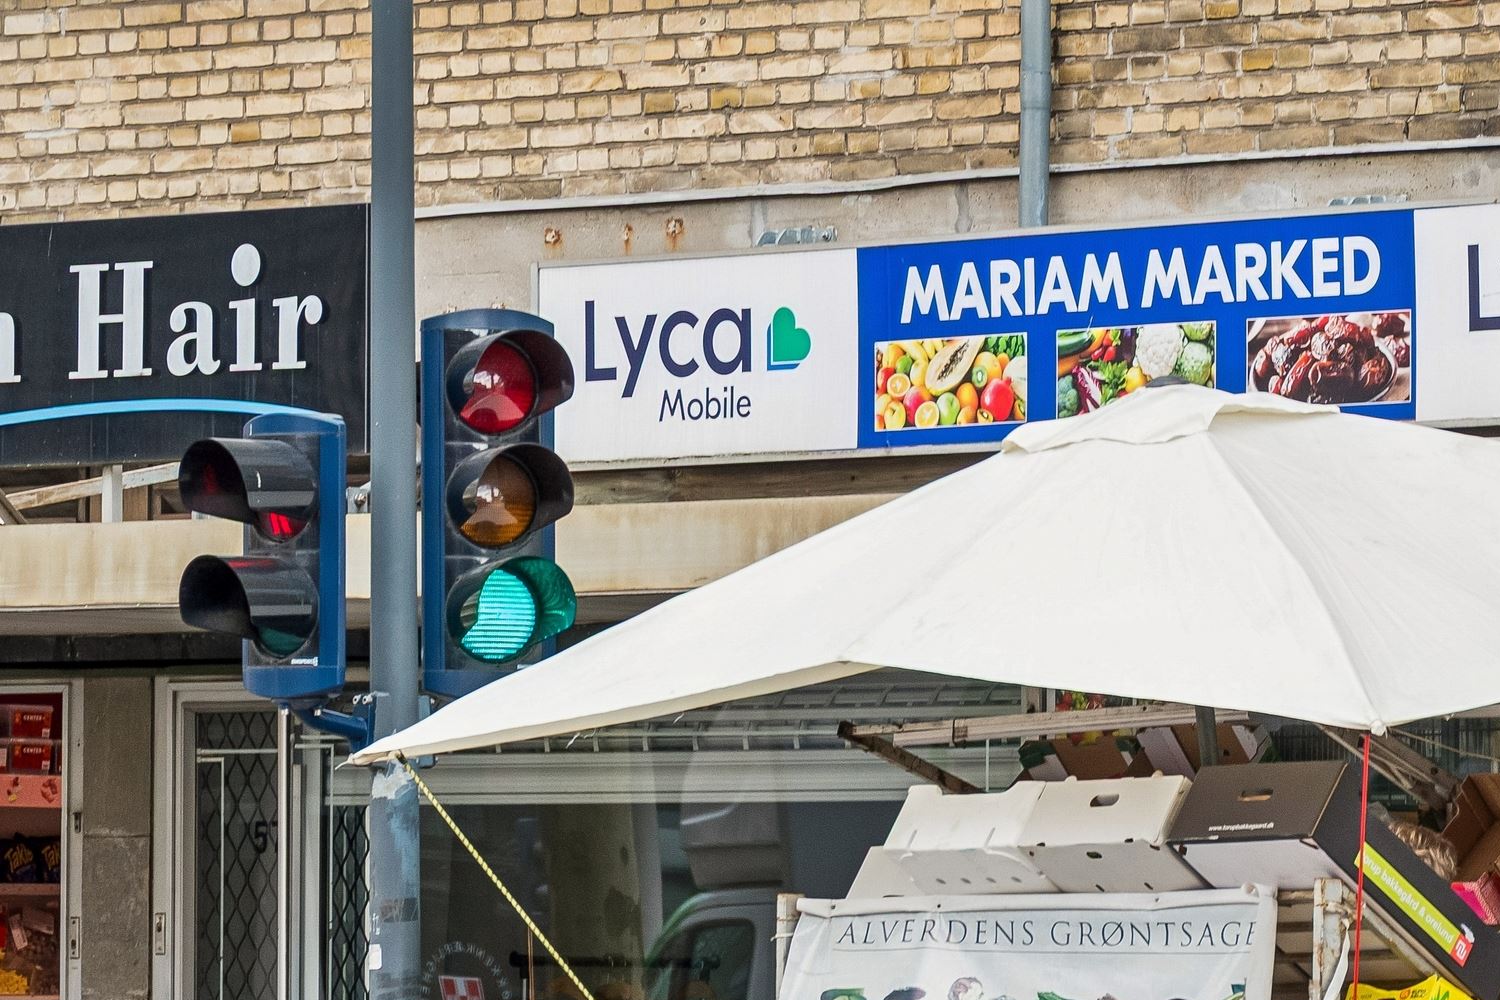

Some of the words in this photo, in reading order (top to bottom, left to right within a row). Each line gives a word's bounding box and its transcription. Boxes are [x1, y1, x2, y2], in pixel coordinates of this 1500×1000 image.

[68, 243, 323, 380] Hair
[900, 255, 1129, 324] MARIAM
[1142, 236, 1381, 309] MARKED
[585, 299, 752, 397] Lyca
[659, 386, 752, 422] Mobile
[837, 919, 1036, 947] ALVERDENS
